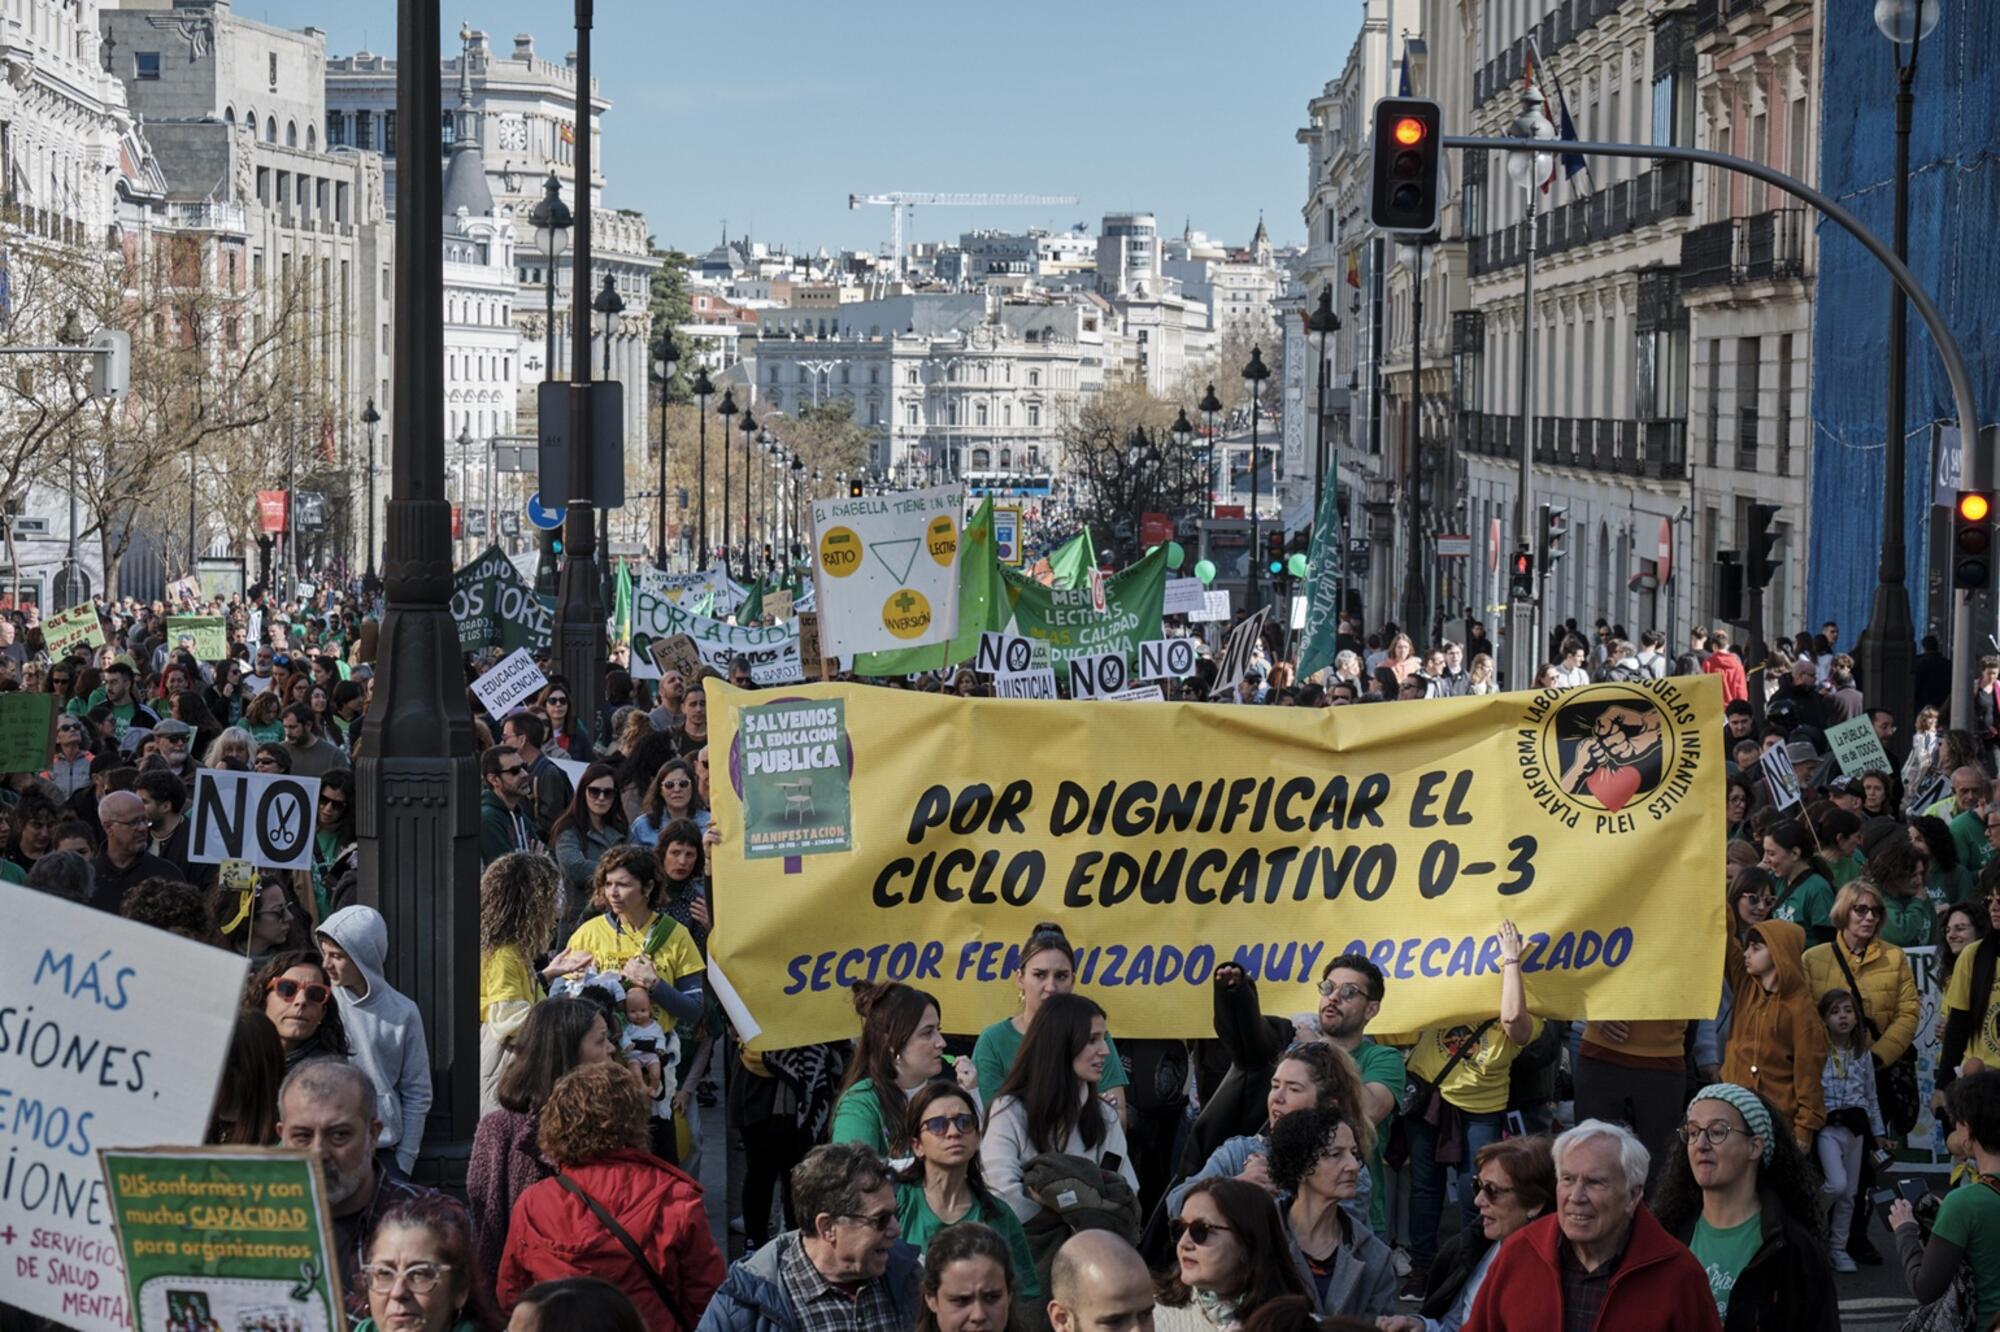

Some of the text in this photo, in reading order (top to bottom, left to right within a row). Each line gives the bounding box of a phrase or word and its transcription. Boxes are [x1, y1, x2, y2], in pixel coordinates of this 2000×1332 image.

[815, 508, 826, 524] EL
[832, 500, 889, 517] ISABELLA
[893, 499, 927, 515] TIENE
[823, 550, 856, 567] RATIO
[1051, 585, 1115, 606] MENS
[638, 593, 687, 635] POR
[885, 611, 931, 631] INVERSIÓN
[978, 633, 1032, 672] NO
[1051, 635, 1134, 661] DUCATIVA
[1141, 640, 1193, 678] NO
[482, 655, 530, 696] EDUCACIÓN
[1070, 654, 1125, 698] NO
[745, 707, 838, 733] SALVEMOS
[745, 734, 764, 750] LA
[747, 744, 841, 776] PÚBLICA
[1517, 729, 1581, 829] PLATAFORMA
[1648, 729, 1702, 820] INFANTILES
[193, 774, 312, 864] NO
[907, 769, 1474, 845] POR DIGNIFICAR EL
[1596, 812, 1636, 834] PLEI
[873, 835, 1538, 909] CICLO EDUCATIVO 0-3
[783, 926, 1634, 995] SECTOR FEMIZADO MUY RECARZADO
[33, 948, 136, 1011] MÁS
[118, 1173, 304, 1201] DISconformes y con
[126, 1205, 308, 1230] mucho CAPACIDAD
[132, 1238, 312, 1262] para organizarnos
[17, 1256, 100, 1291] DE SALUD
